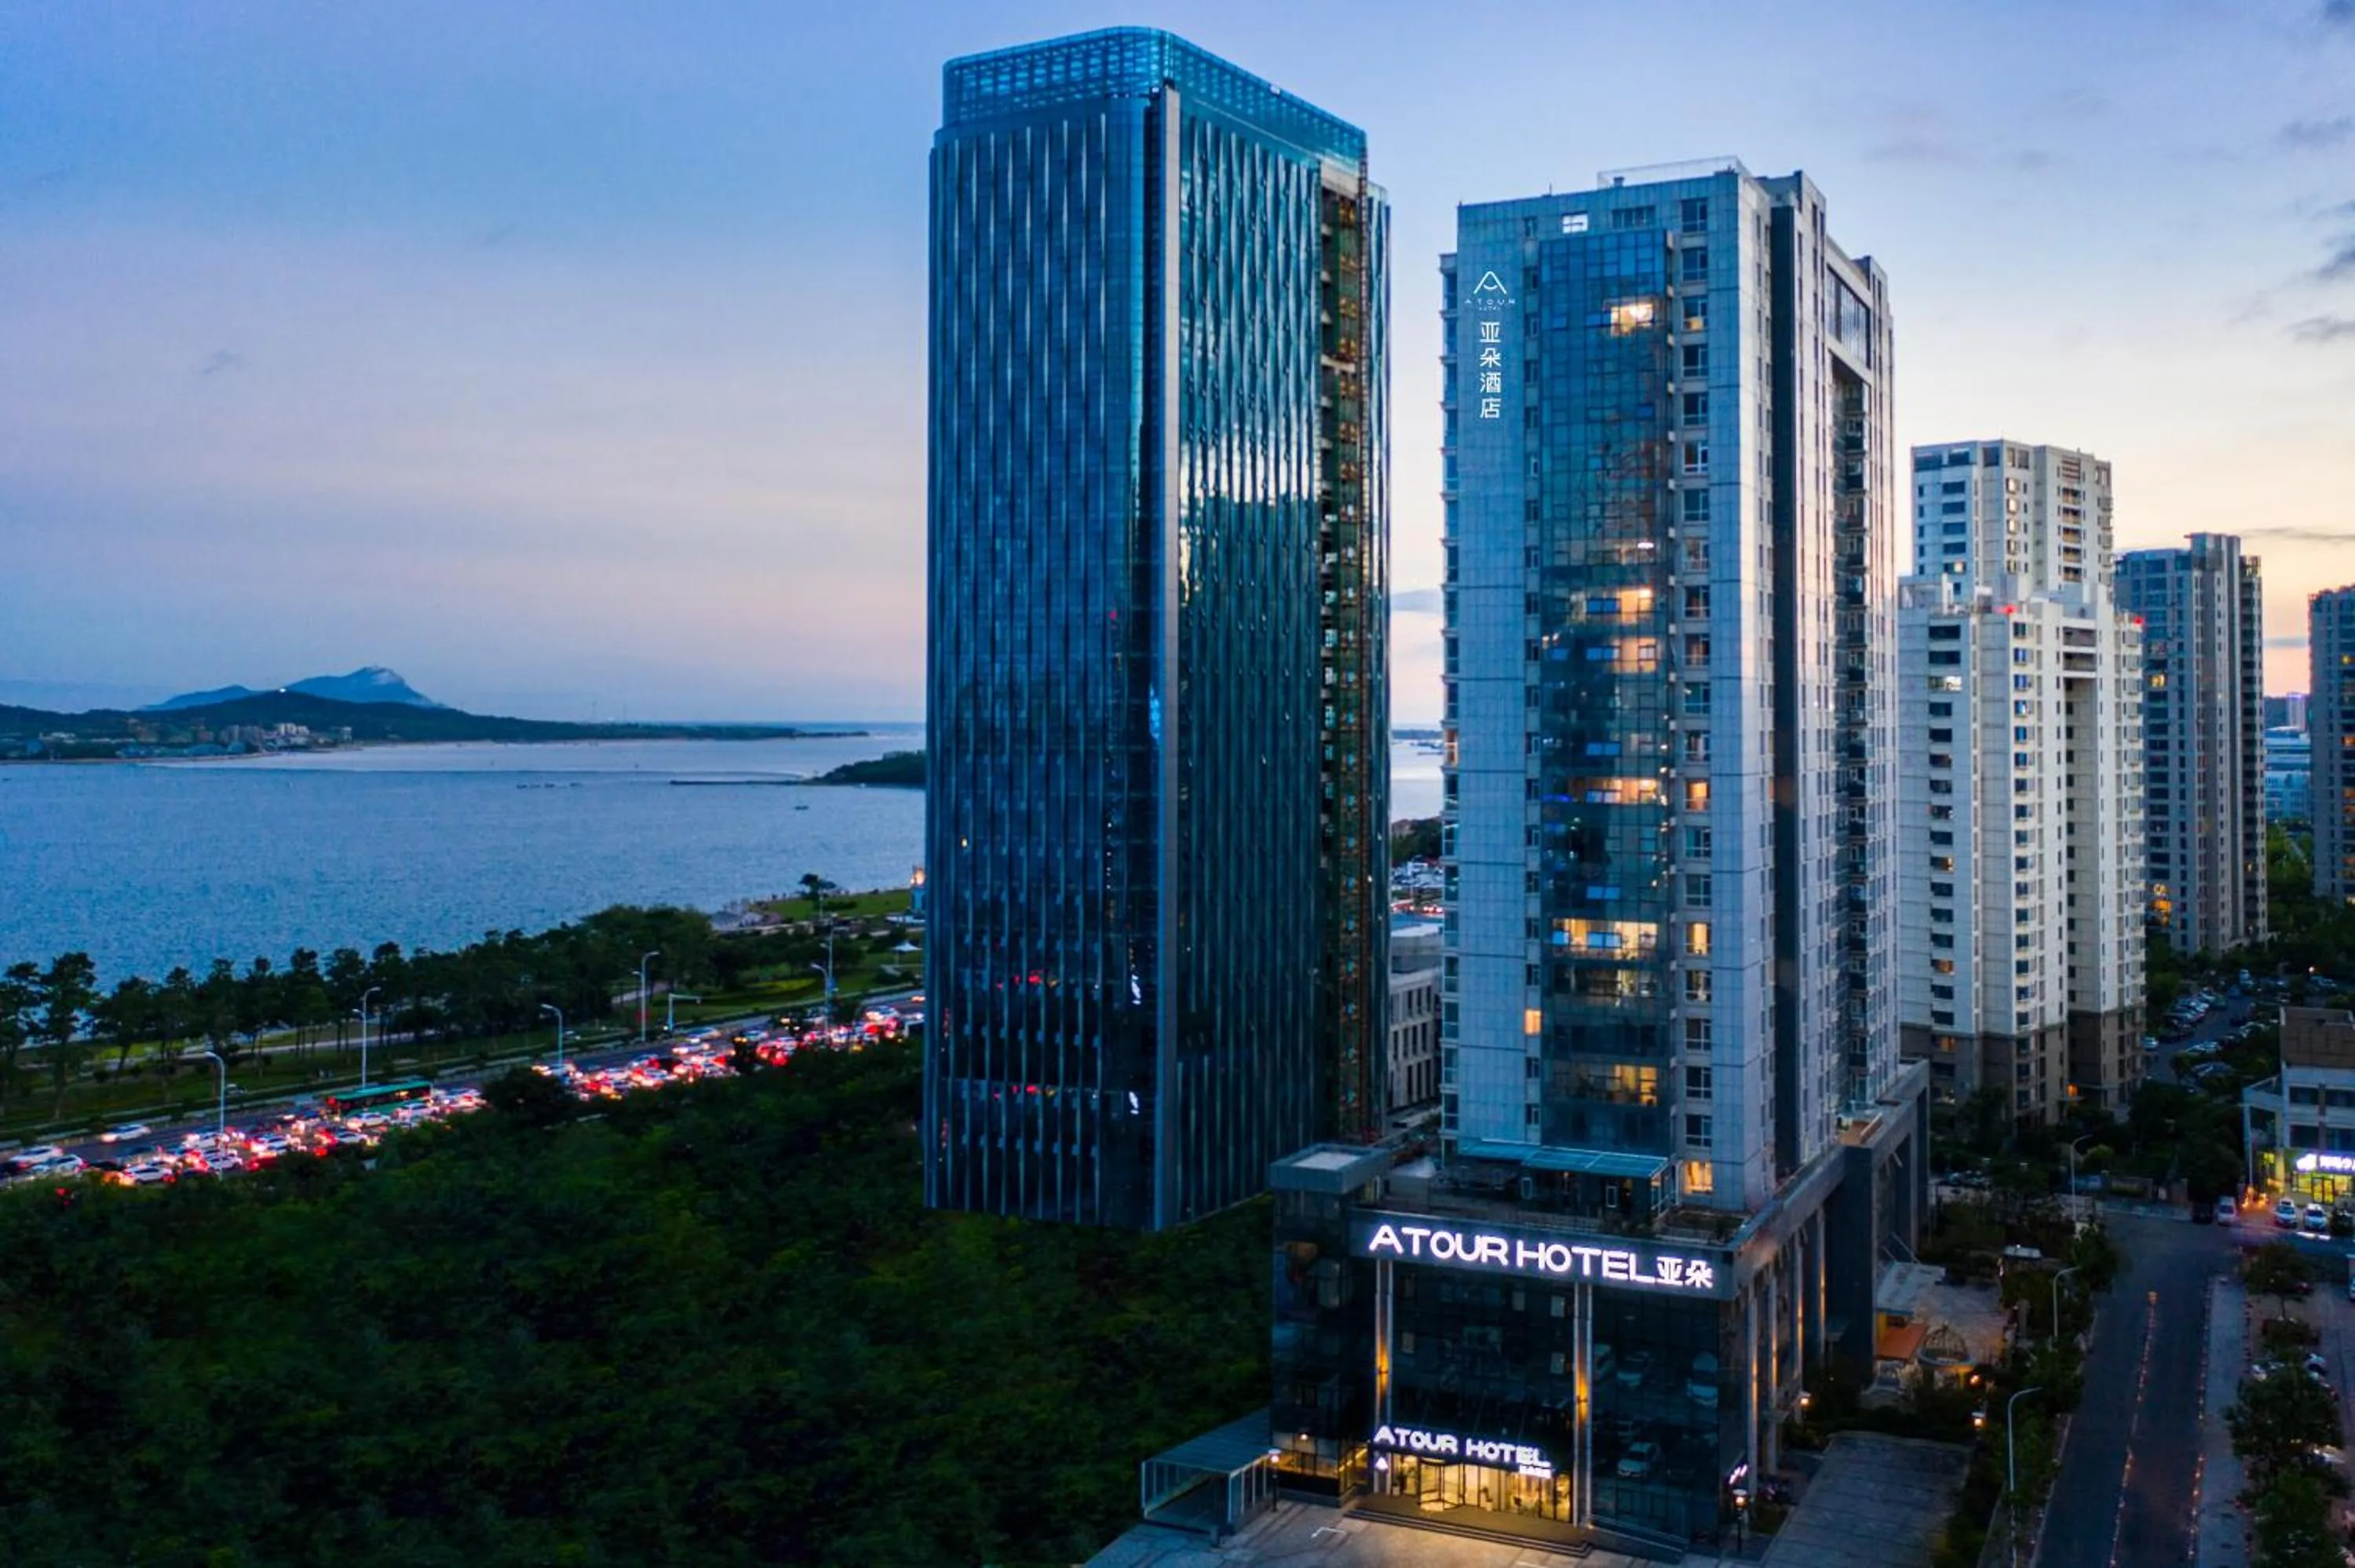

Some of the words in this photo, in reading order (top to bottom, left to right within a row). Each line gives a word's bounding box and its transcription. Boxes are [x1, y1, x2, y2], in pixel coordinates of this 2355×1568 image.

[1479, 321, 1502, 418] 亚朵酒店
[1369, 1224, 1509, 1266] ATOUR
[1517, 1240, 1656, 1283] HOTEL
[1657, 1256, 1713, 1289] 亚朵
[1374, 1425, 1458, 1454] ATOUR
[1466, 1437, 1551, 1468] HOTEL
